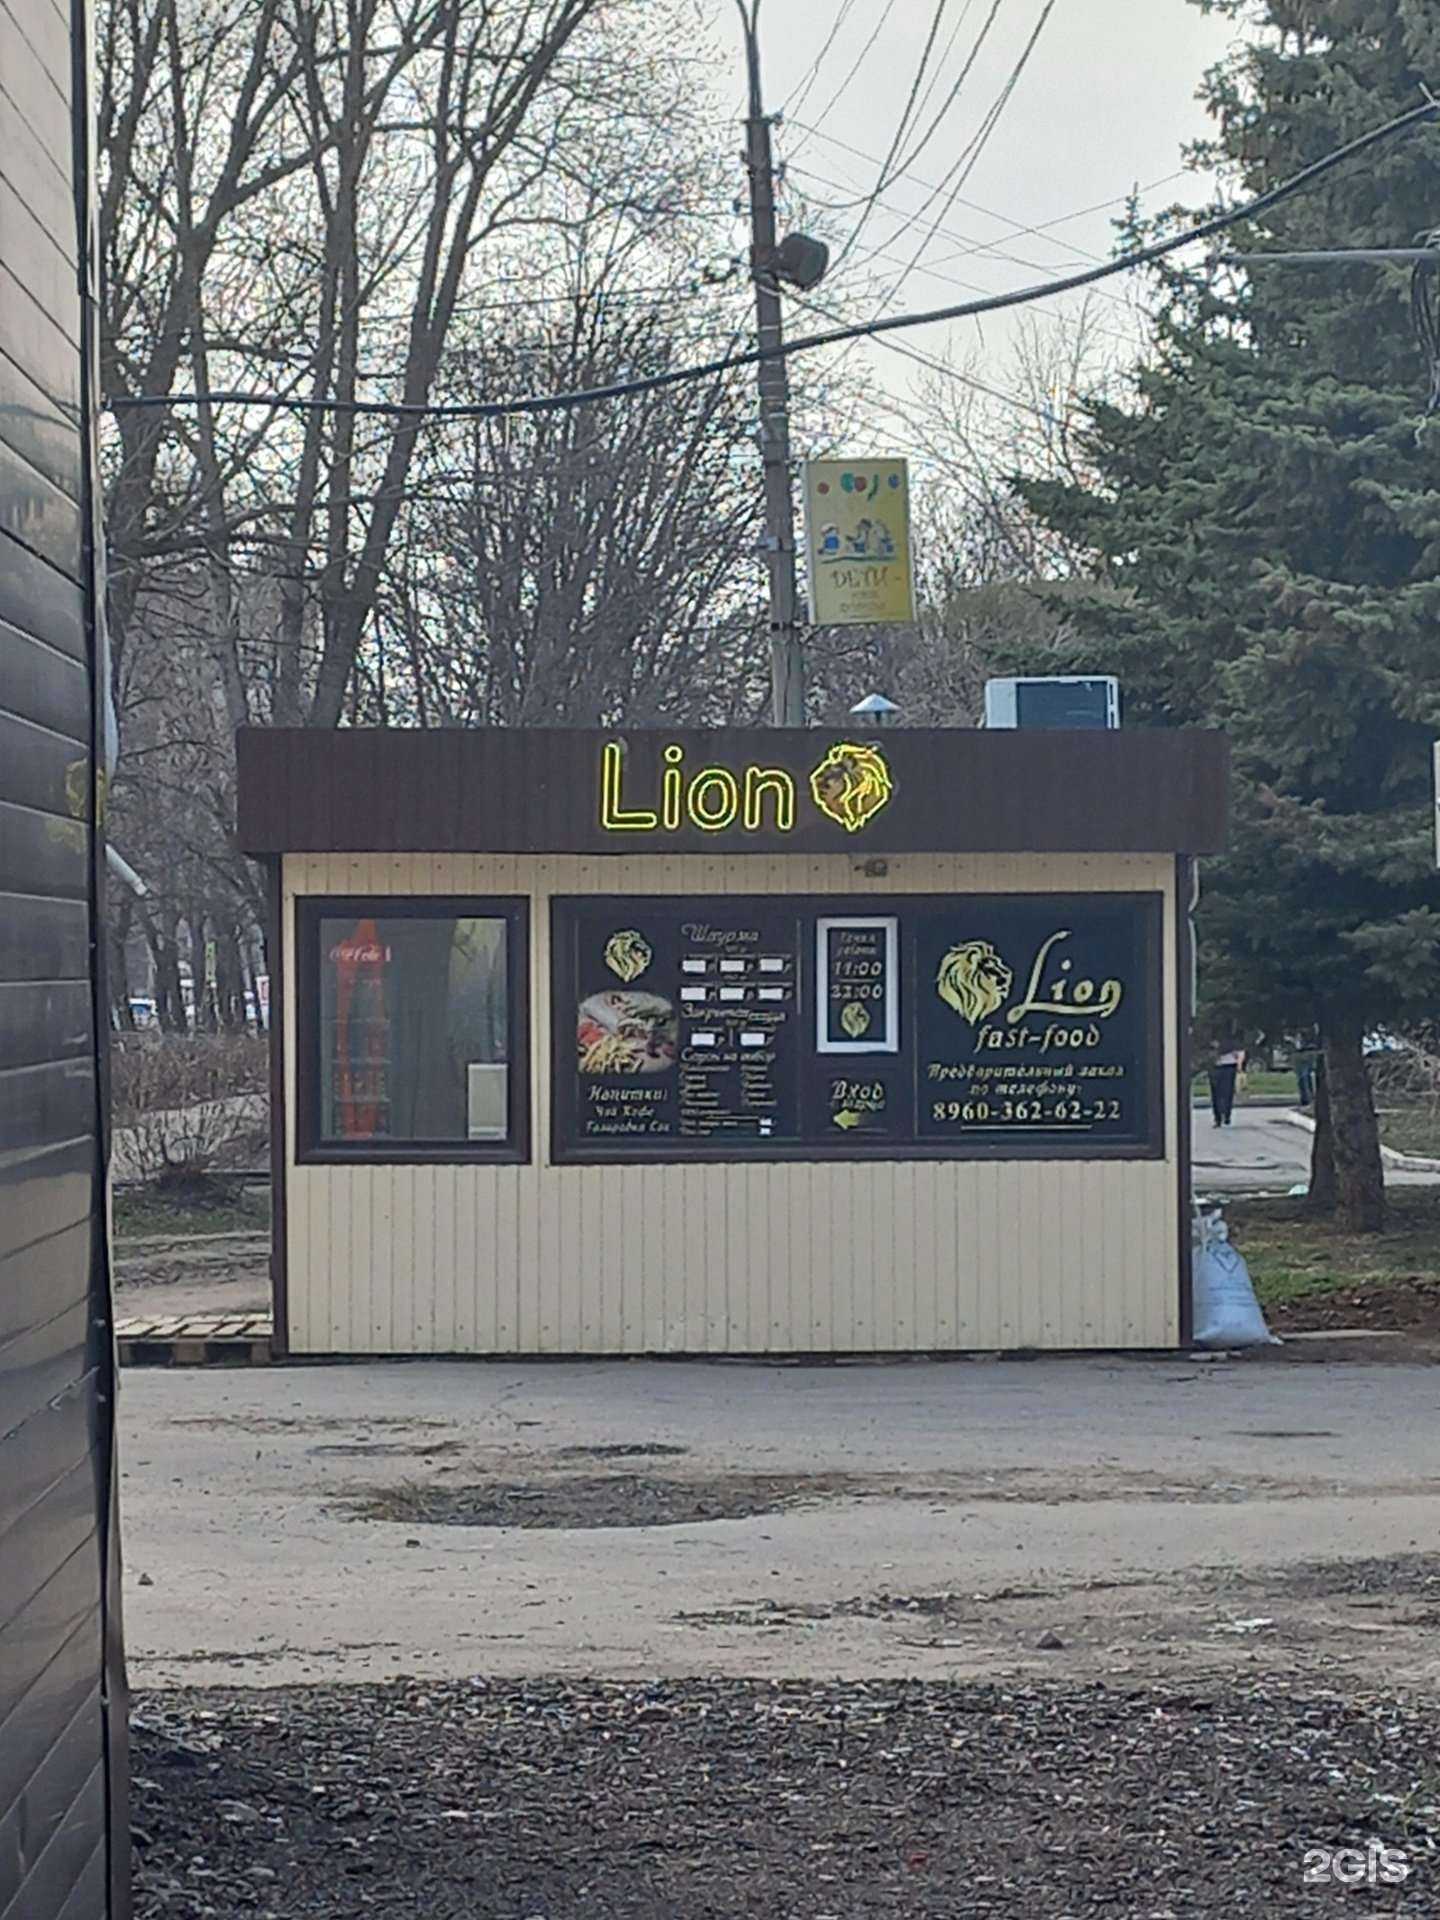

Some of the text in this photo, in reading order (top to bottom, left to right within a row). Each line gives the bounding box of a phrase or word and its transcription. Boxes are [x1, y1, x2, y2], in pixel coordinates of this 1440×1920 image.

[602, 744, 794, 829] Lion
[1007, 930, 1121, 1025] Lion
[973, 1023, 1100, 1053] fast-food
[932, 1100, 1121, 1121] 8960-362-62-22
